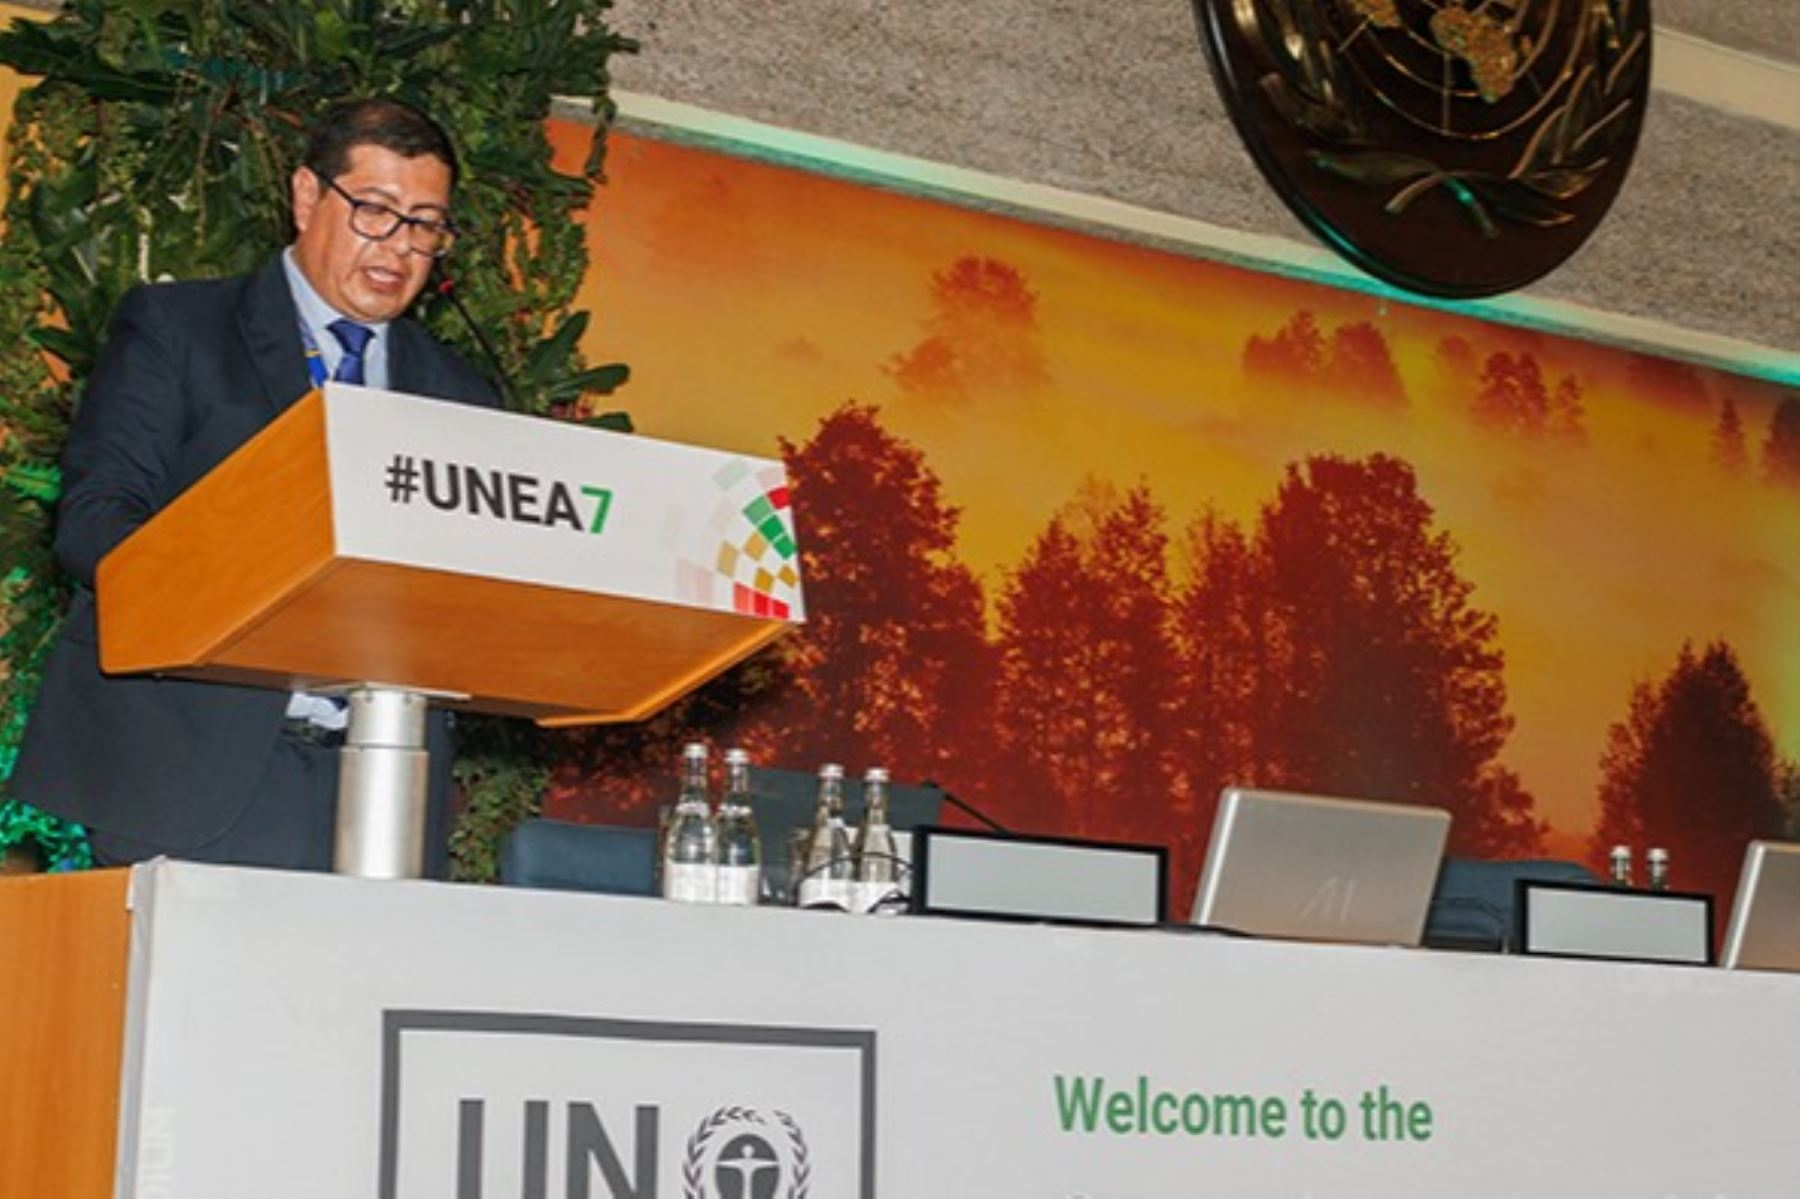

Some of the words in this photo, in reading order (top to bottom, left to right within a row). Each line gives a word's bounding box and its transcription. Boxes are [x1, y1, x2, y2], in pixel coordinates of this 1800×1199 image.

[384, 454, 614, 535] #UNEA7
[456, 1097, 661, 1199] UN
[1054, 1075, 1287, 1138] Welcome
[1300, 1089, 1347, 1141] to
[1359, 1084, 1434, 1142] the
